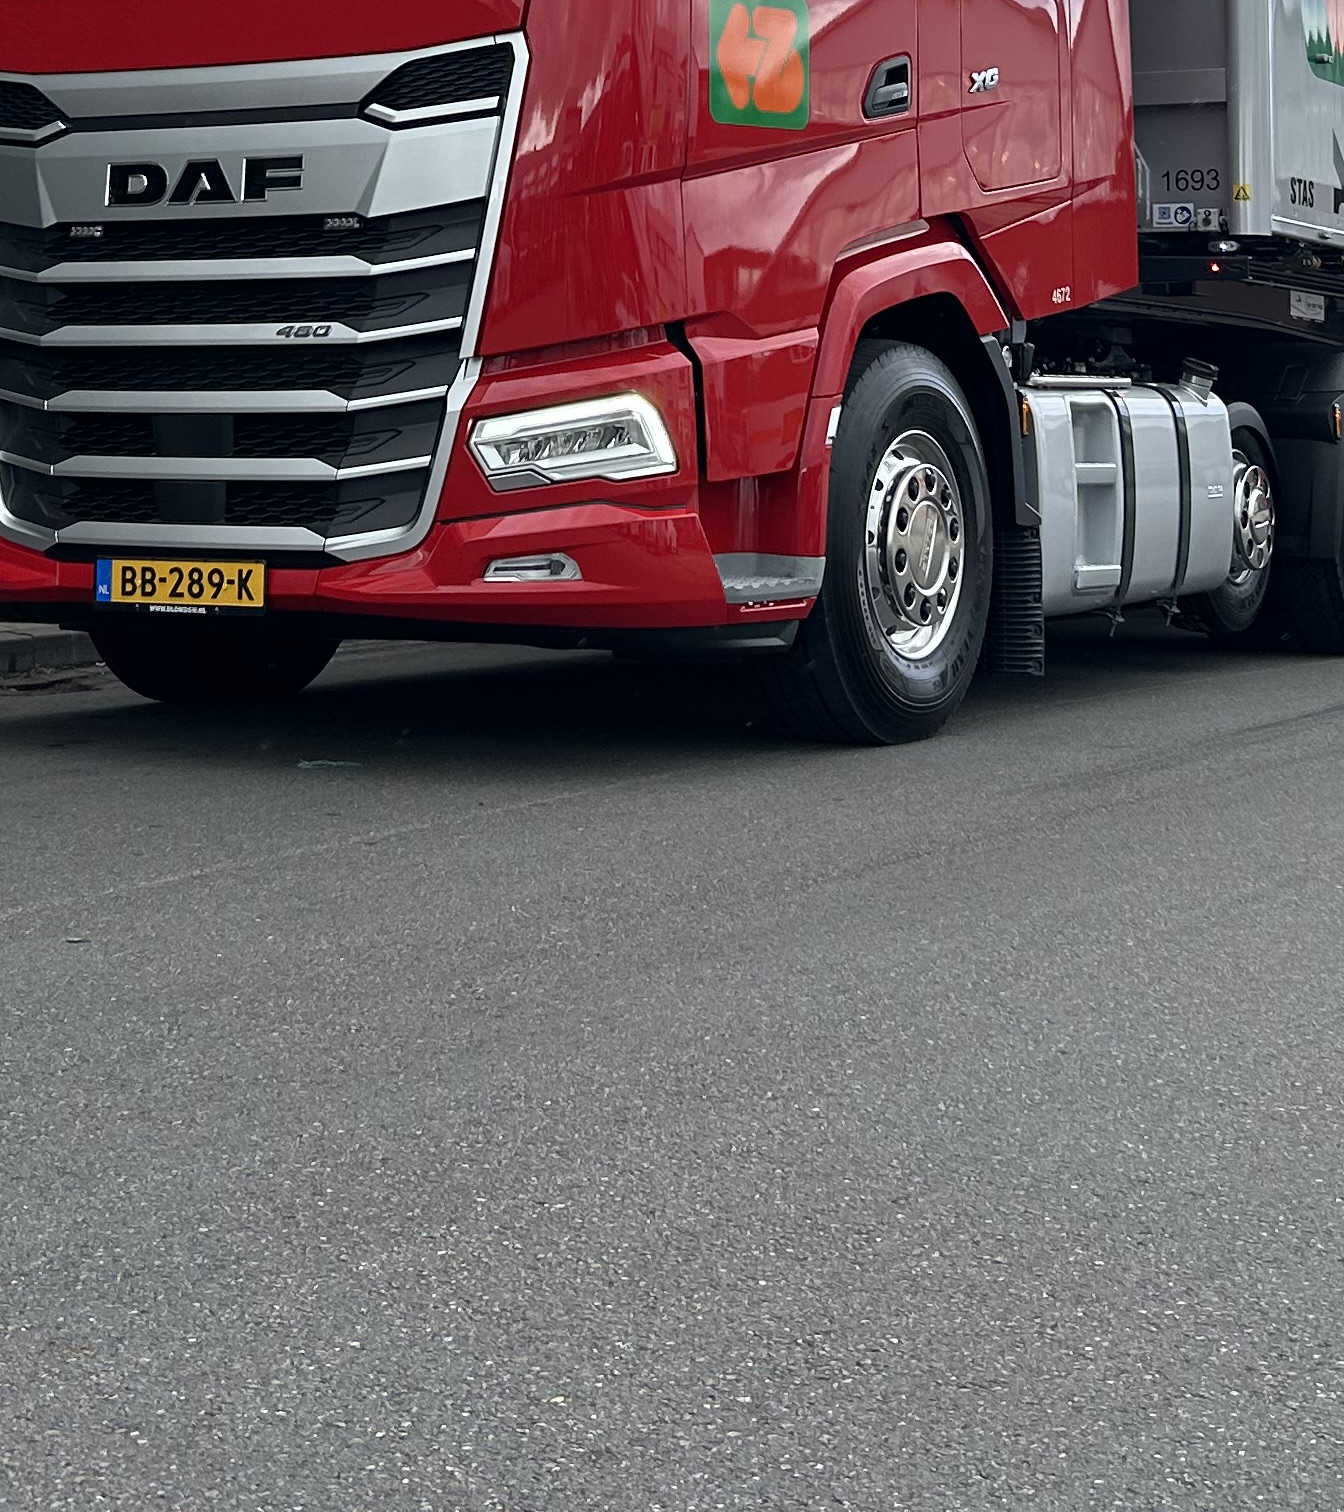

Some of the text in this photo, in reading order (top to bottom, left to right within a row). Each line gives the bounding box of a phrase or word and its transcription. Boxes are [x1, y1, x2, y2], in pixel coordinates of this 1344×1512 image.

[969, 67, 999, 93] XG
[104, 153, 305, 208] DAF
[1161, 168, 1220, 192] 1693
[1290, 177, 1314, 208] STAS
[98, 565, 255, 601] NL BB-289-K
